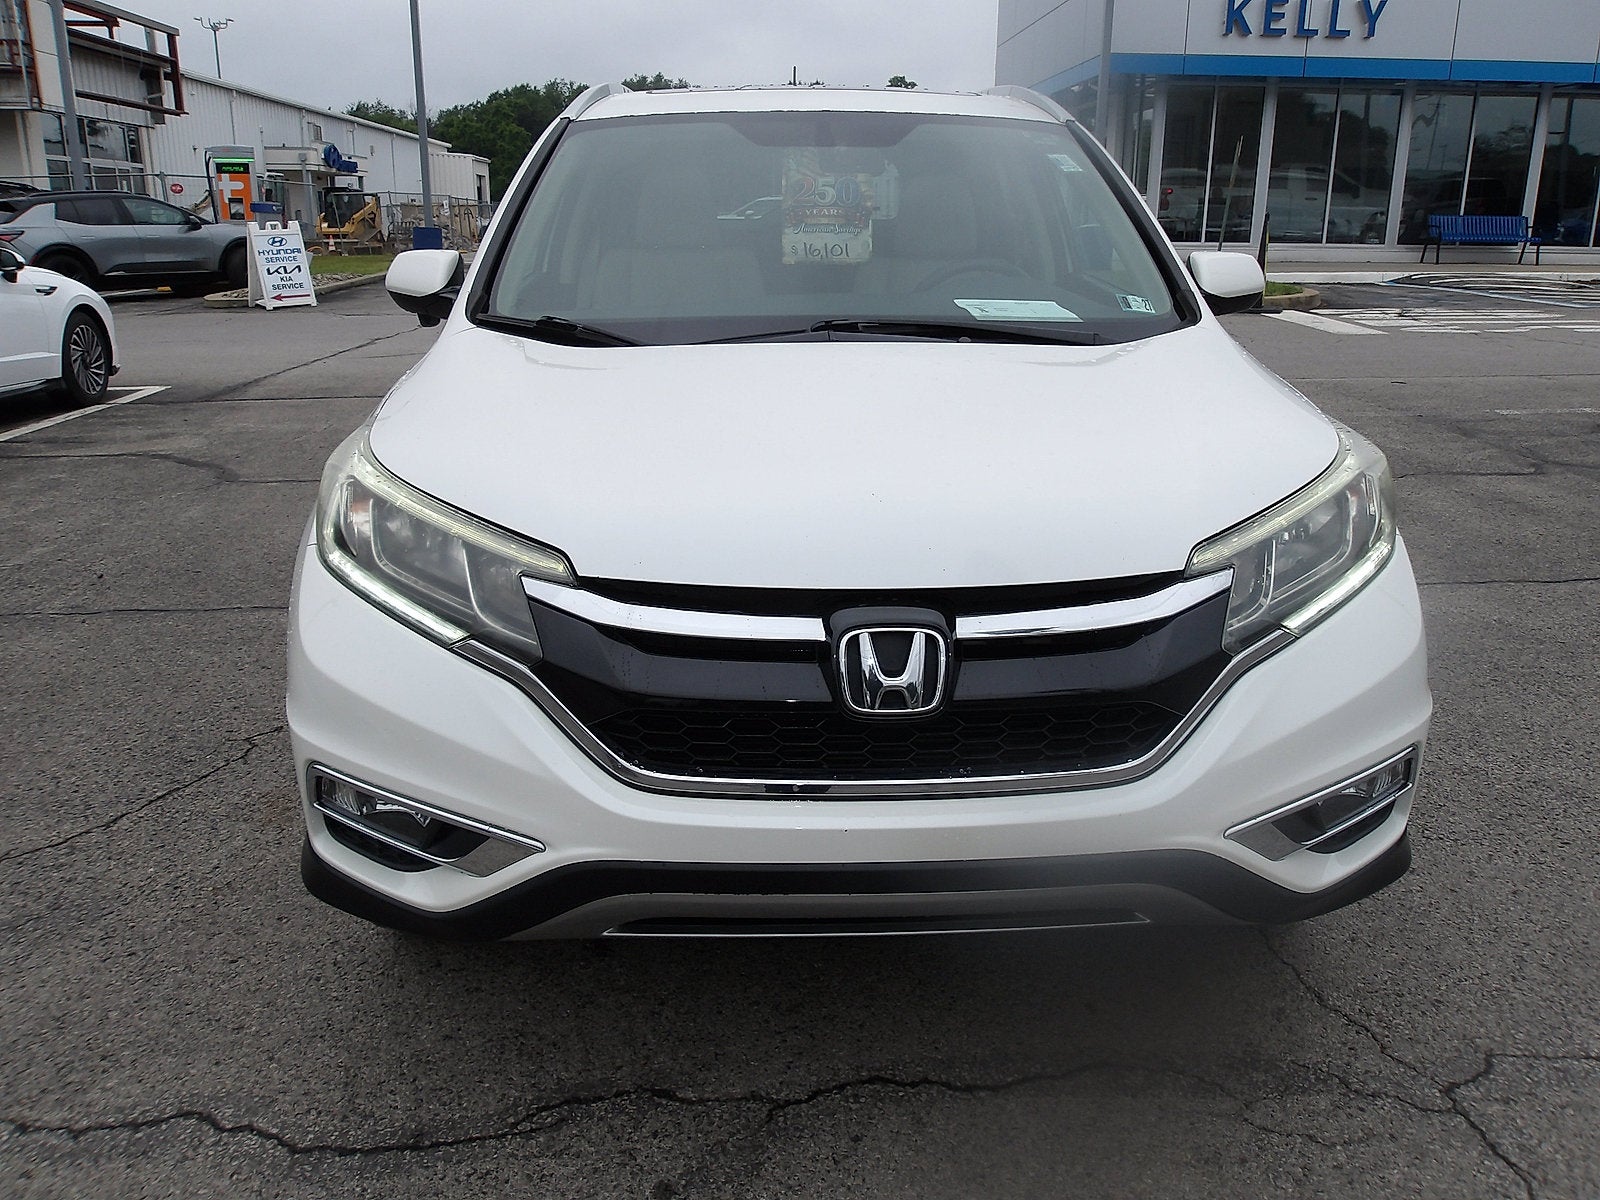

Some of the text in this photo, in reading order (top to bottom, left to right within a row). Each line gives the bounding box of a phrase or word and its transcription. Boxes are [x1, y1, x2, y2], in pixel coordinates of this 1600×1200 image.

[1223, 0, 1388, 39] KELLY
[792, 176, 859, 206] 250
[258, 248, 301, 256] HYUNDAI
[265, 255, 298, 264] SERVICE
[272, 282, 304, 291] SERVICE
